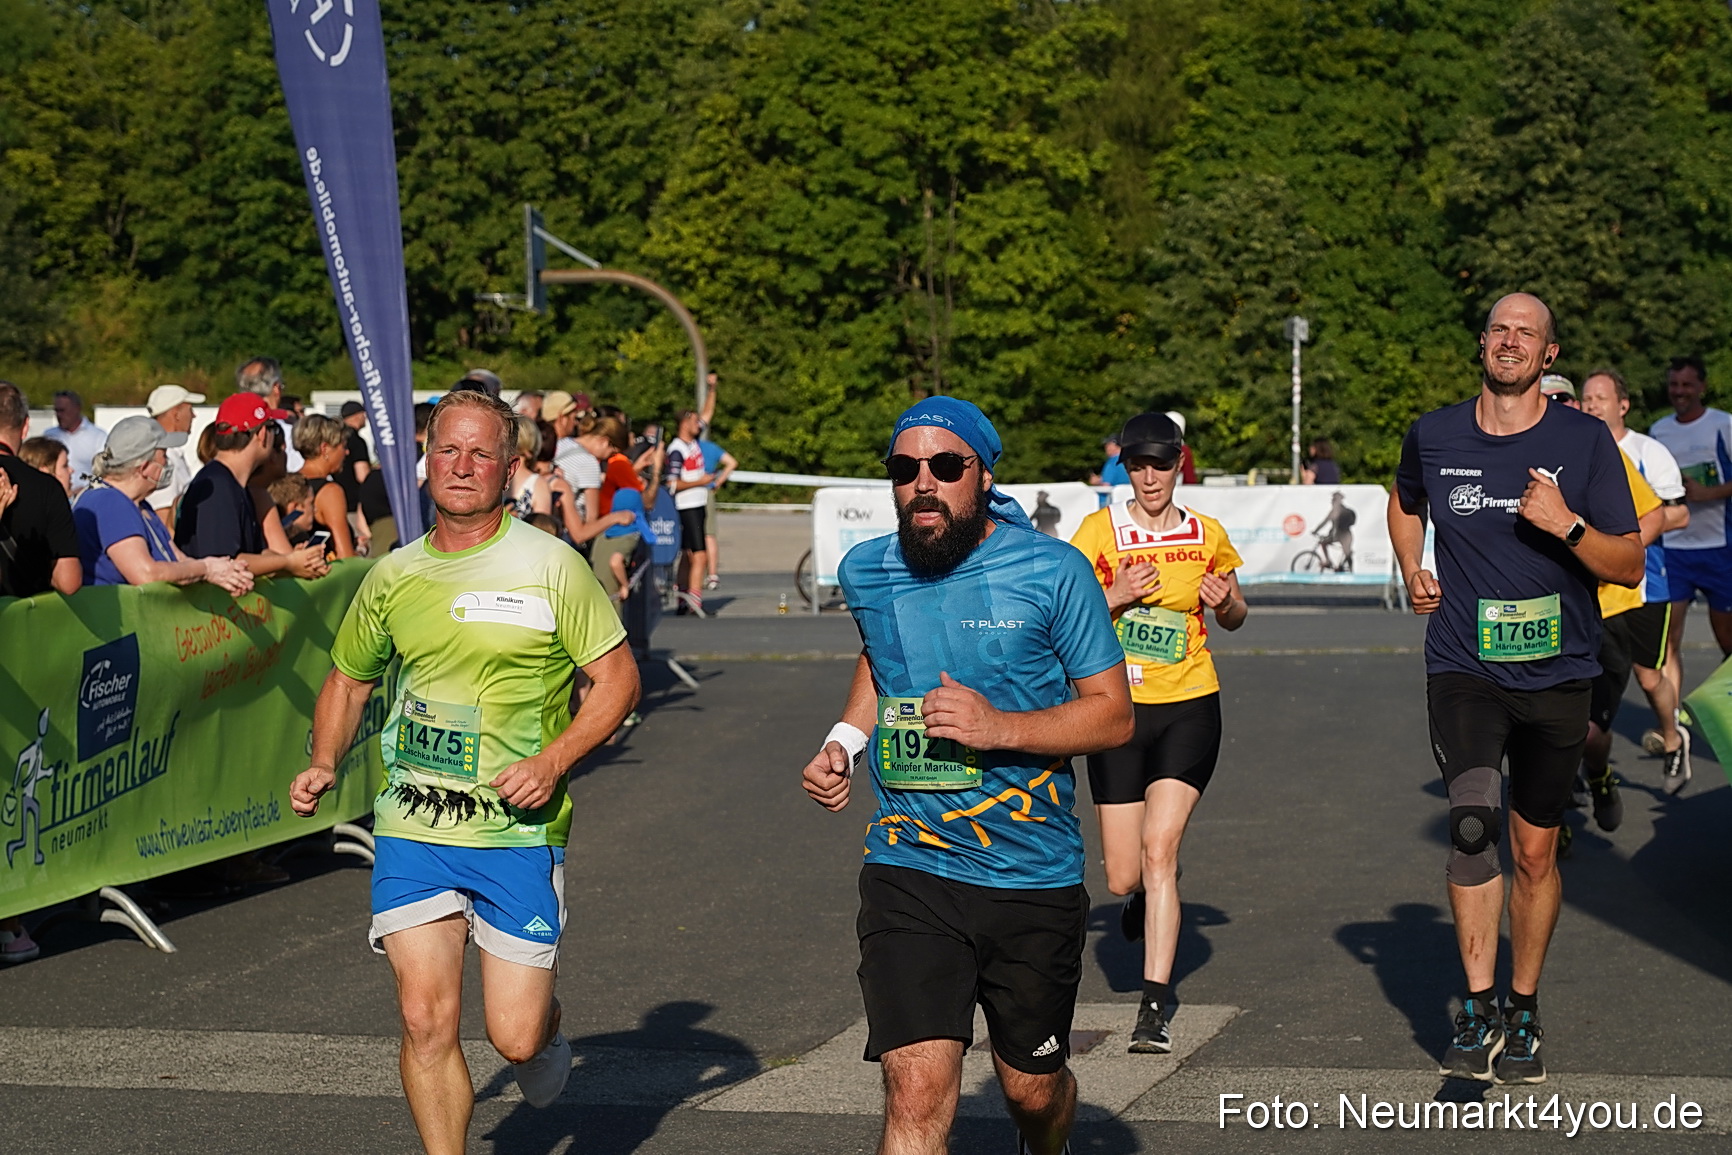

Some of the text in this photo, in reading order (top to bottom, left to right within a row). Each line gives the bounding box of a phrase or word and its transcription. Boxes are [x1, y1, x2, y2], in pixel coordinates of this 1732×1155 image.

[900, 413, 955, 427] PLAST
[1446, 468, 1483, 477] PFLEIDERER
[1482, 497, 1521, 508] Firmen
[1165, 548, 1206, 563] BÖGL
[495, 602, 523, 610] Neumarkt
[496, 596, 524, 605] Klinikum
[960, 619, 1026, 629] TR PLAST
[1126, 620, 1177, 646] 1657
[1493, 619, 1549, 642] 1768
[1550, 619, 1558, 648] 2022
[1126, 639, 1144, 651] Lang
[1145, 643, 1169, 654] Milena
[1174, 632, 1185, 659] 2022
[1482, 627, 1492, 649] RUN
[1495, 640, 1548, 652] Häring Martin
[88, 673, 133, 702] Fischer
[896, 714, 924, 722] Firmenlau
[398, 724, 406, 751] RUN
[406, 721, 463, 756] 1475
[403, 744, 431, 761] Zaschka
[432, 753, 464, 767] Markus
[463, 736, 474, 772] 2022
[882, 738, 891, 770] RUN
[965, 746, 977, 776] 202
[50, 710, 181, 826] firmenlauf
[891, 761, 964, 774] Knipfer Markus
[51, 807, 108, 855] neumarkt
[1032, 1043, 1060, 1057] adidas
